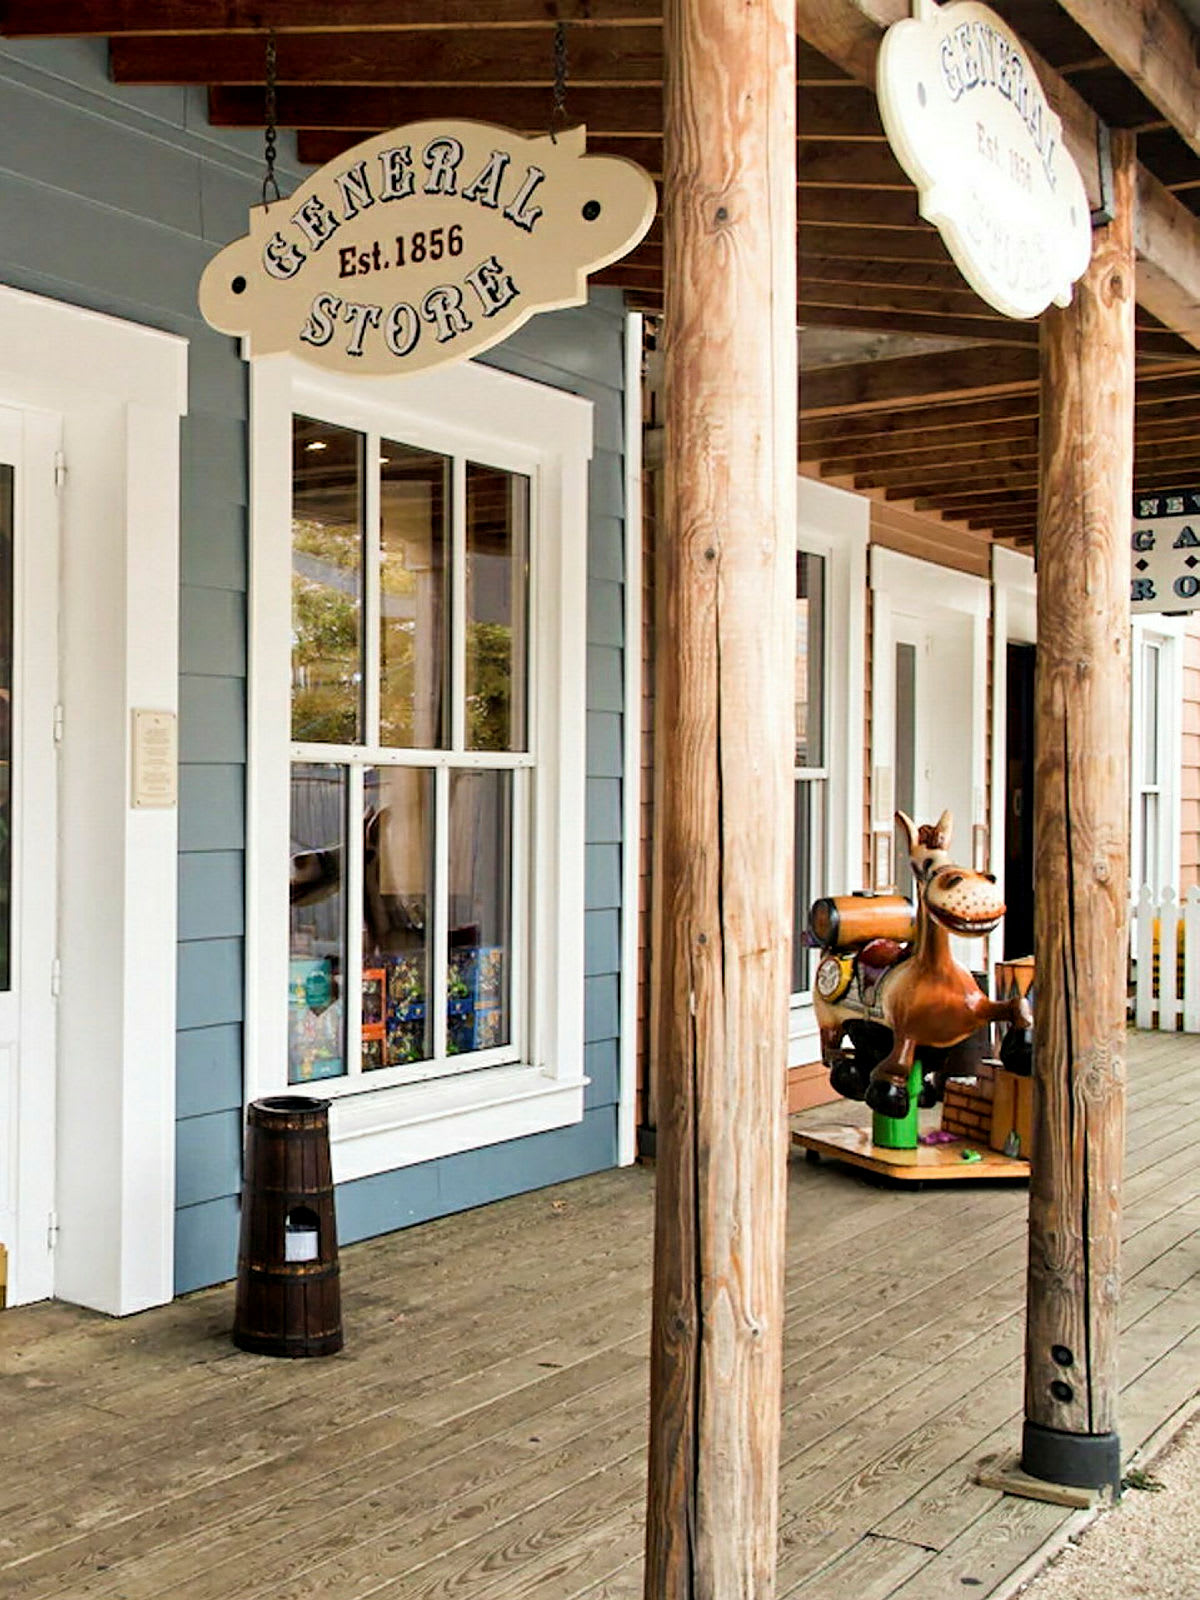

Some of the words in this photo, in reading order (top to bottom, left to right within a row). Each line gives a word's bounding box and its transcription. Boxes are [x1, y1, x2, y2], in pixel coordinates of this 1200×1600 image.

[940, 20, 1057, 191] GENERAL
[262, 136, 546, 279] GENERAL
[299, 256, 520, 357] STORE
